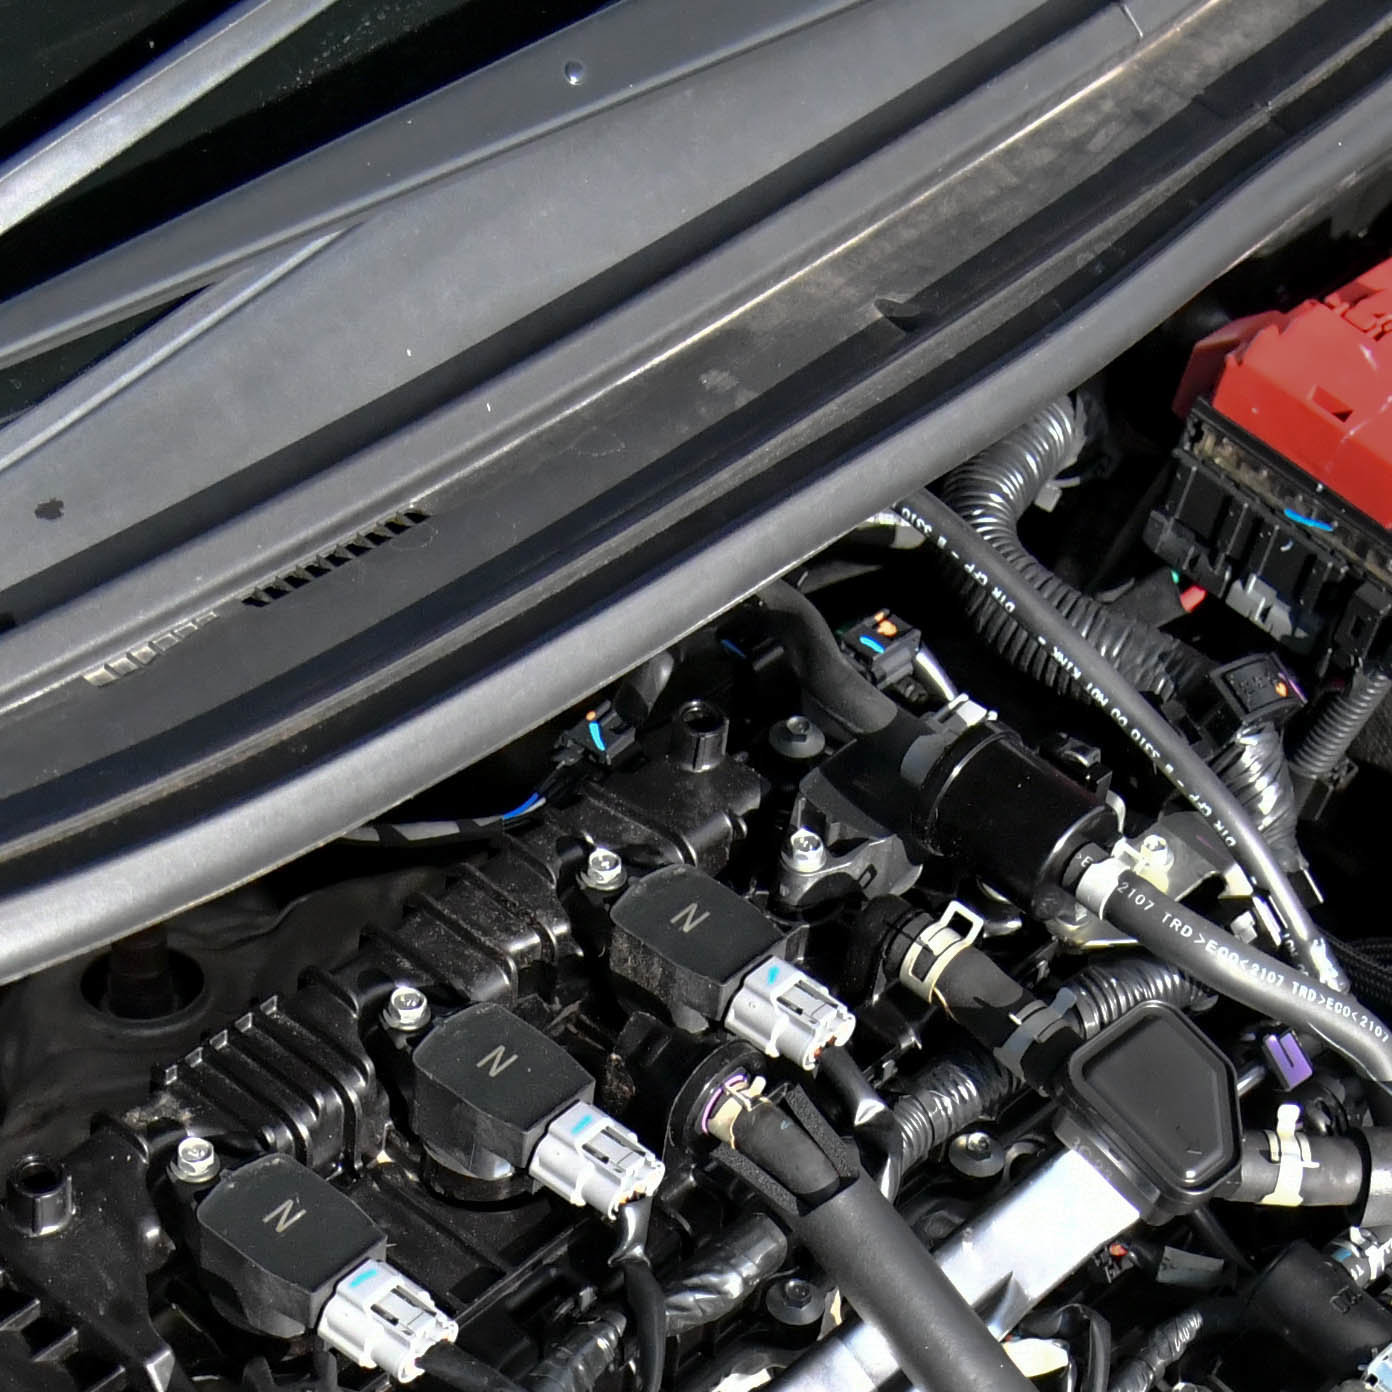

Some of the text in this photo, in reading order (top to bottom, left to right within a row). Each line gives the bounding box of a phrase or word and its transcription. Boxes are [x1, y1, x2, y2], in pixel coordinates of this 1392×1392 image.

[668, 903, 710, 935] N
[475, 1044, 518, 1079] N
[261, 1198, 307, 1233] N
